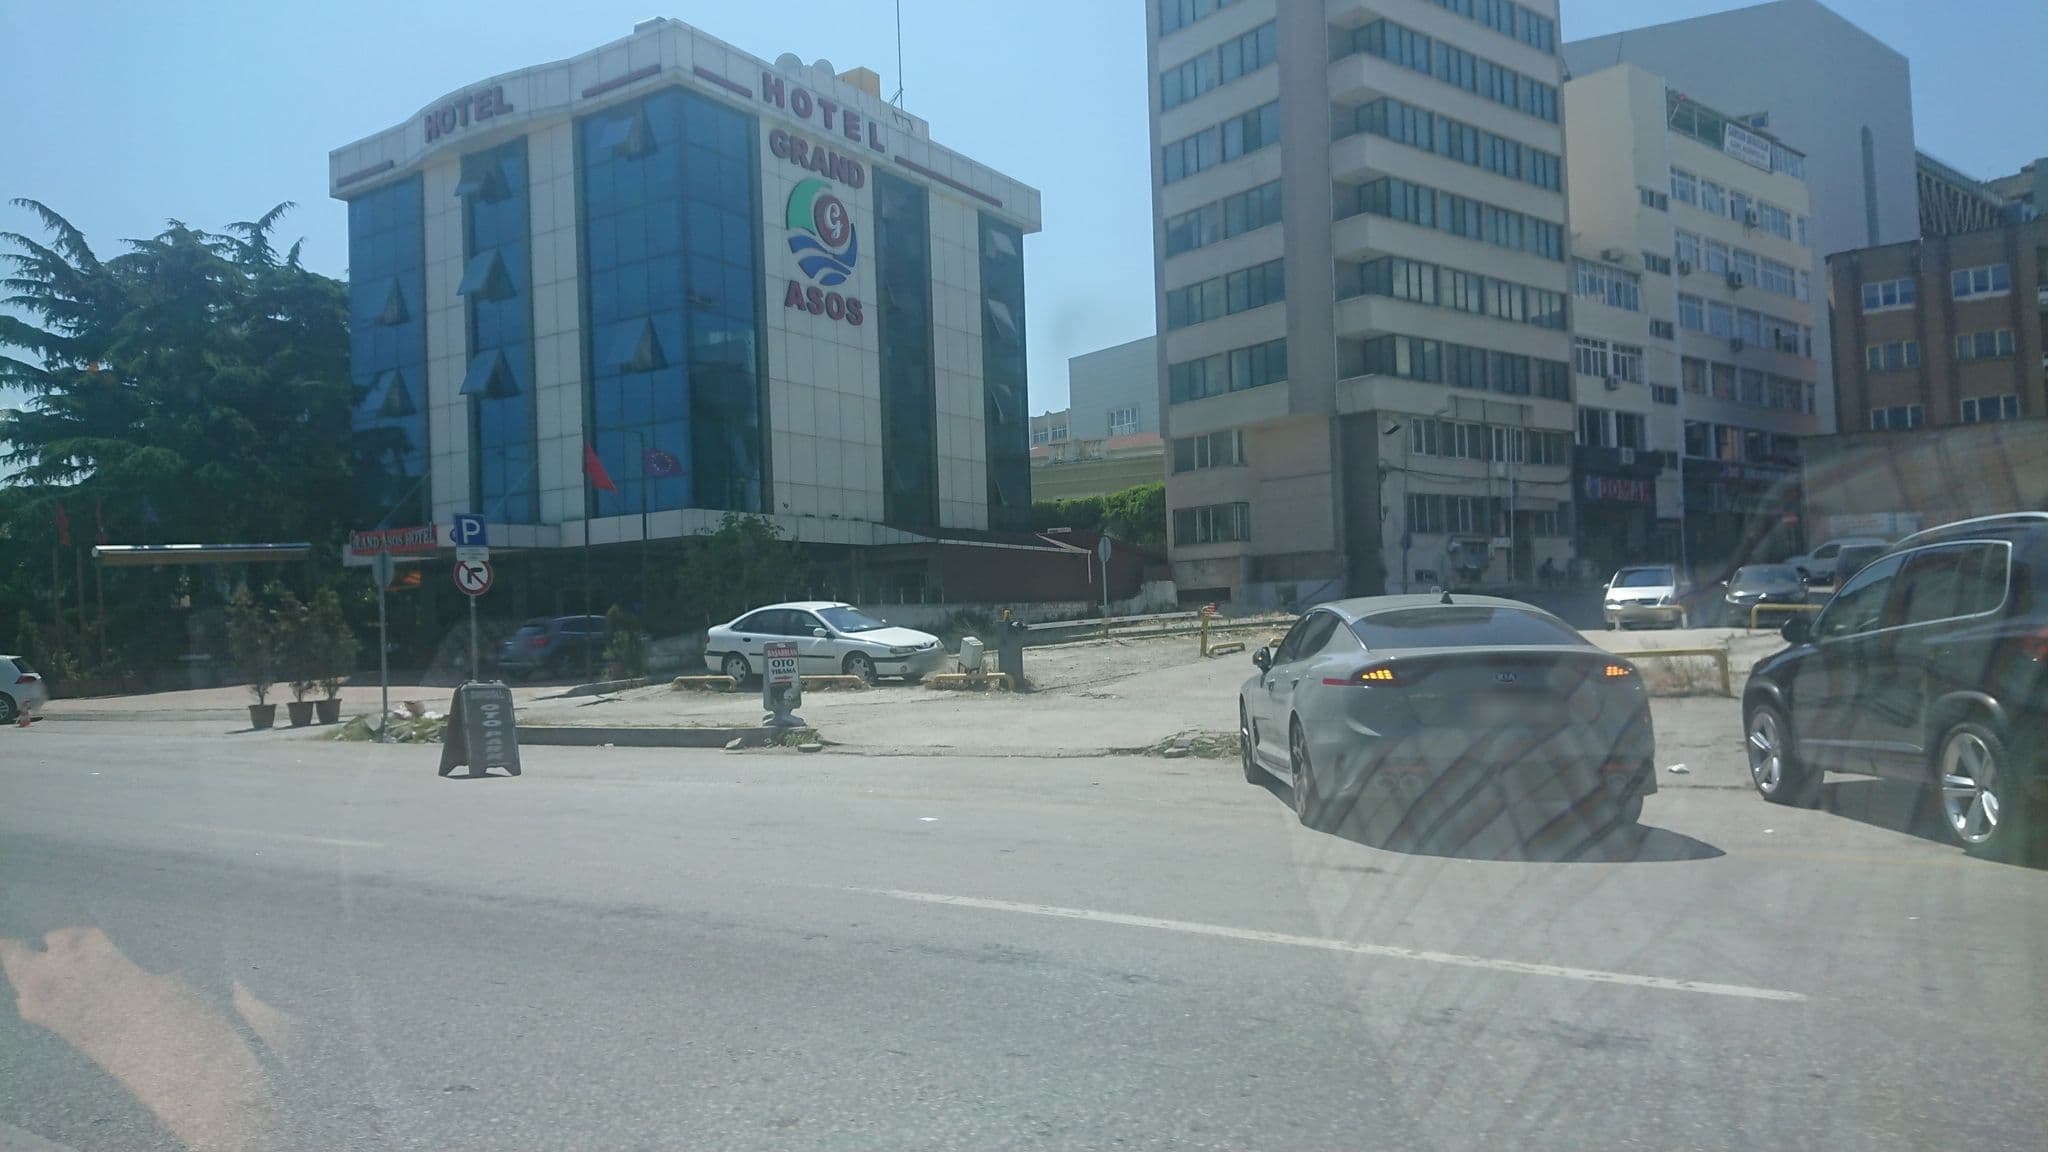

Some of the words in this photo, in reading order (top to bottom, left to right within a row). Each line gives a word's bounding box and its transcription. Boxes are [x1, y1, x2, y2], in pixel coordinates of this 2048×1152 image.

[423, 85, 515, 144] HOTEL
[762, 71, 886, 153] HOTEL
[769, 128, 865, 189] GRAND
[784, 279, 865, 326] ASOS
[348, 528, 380, 550] GRAND
[405, 520, 436, 546] HOTEL
[461, 517, 481, 546] P
[772, 659, 794, 667] OTO
[1496, 672, 1516, 681] KIA
